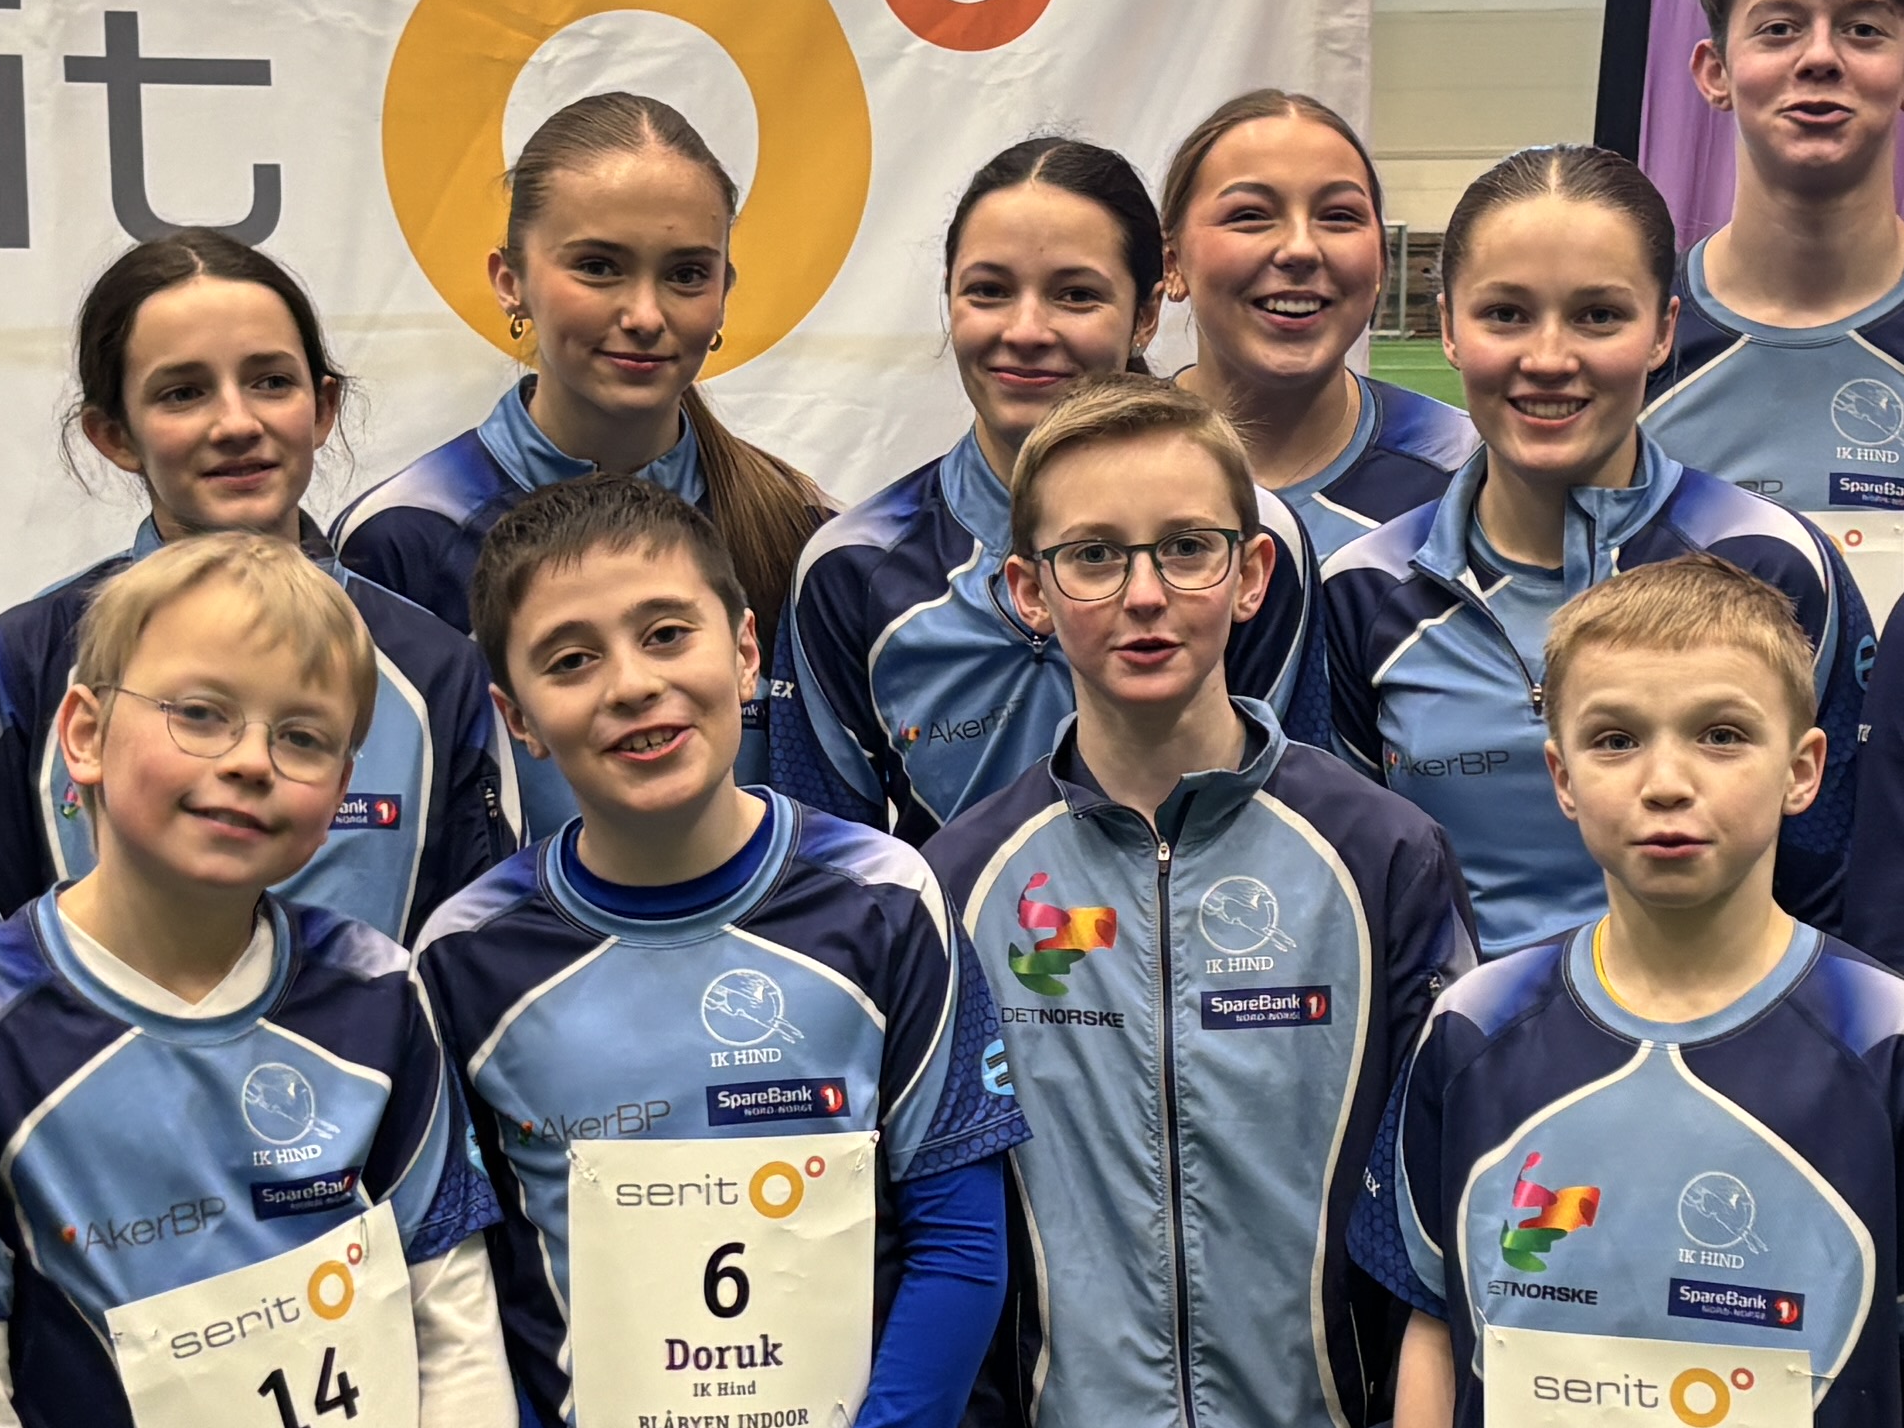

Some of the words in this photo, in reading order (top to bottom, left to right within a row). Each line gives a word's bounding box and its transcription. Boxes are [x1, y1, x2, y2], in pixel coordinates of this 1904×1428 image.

[1836, 447, 1852, 459] IK
[1857, 449, 1899, 463] HIND
[1205, 959, 1226, 974] IK
[1228, 956, 1274, 972] HIND
[1210, 994, 1301, 1013] SpareBank
[711, 1052, 730, 1067] IK
[734, 1048, 782, 1063] HIND
[717, 1085, 812, 1109] SpareBank
[541, 1099, 671, 1142] AkerBP
[253, 1151, 272, 1166] IK
[276, 1144, 322, 1164] HIND
[615, 1175, 738, 1207] serit
[83, 1196, 227, 1252] AkerBP
[1679, 1248, 1696, 1262] IK
[1700, 1251, 1744, 1269] HIND
[703, 1242, 749, 1318] 6
[1680, 1286, 1767, 1310] SpareBank
[170, 1289, 301, 1360] serit
[664, 1334, 783, 1371] Doruk
[692, 1382, 712, 1396] IK
[717, 1380, 756, 1396] Hind
[1533, 1371, 1658, 1409] serit
